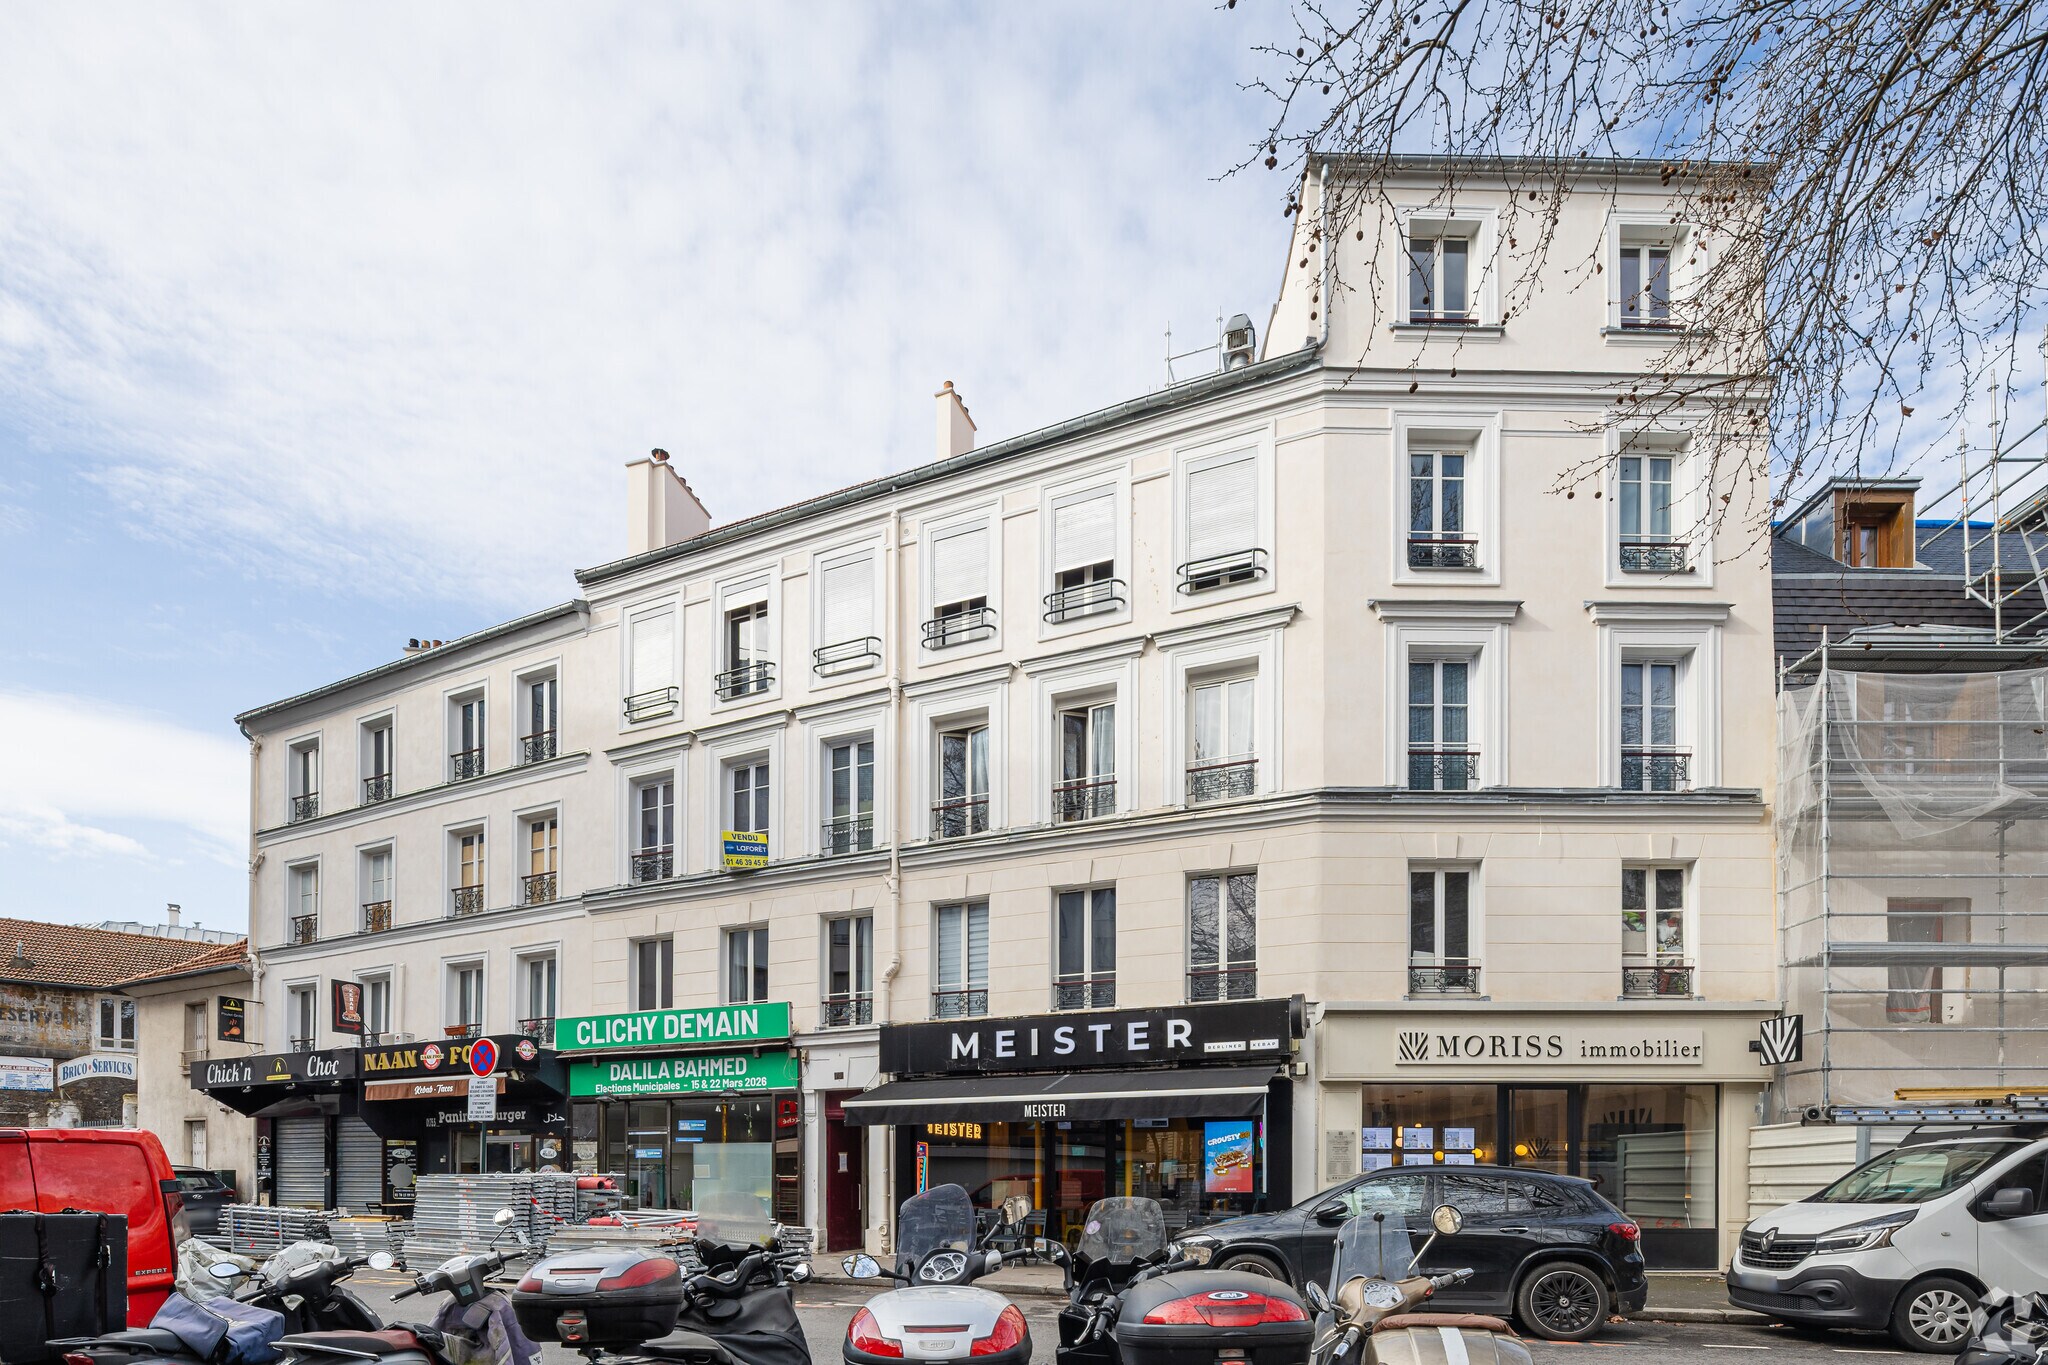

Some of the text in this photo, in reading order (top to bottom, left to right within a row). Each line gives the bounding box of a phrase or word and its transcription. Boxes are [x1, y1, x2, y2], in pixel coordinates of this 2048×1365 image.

[731, 833, 758, 841] VENDU
[576, 1009, 758, 1045] CLICHY DEMAIN
[951, 1019, 1192, 1060] MEISTER
[1436, 1034, 1701, 1058] MORISS immobilier
[62, 1063, 87, 1081] BRICO
[92, 1059, 132, 1075] SERVICES
[207, 1055, 340, 1084] Chick'n Choc
[364, 1050, 417, 1071] NAAN
[609, 1057, 747, 1081] DALILA BAHMED
[414, 1085, 433, 1095] Kebab
[437, 1084, 454, 1093] Tacos
[595, 1083, 632, 1094] Elections
[632, 1081, 680, 1093] Municipales
[691, 1080, 700, 1091] 15
[701, 1080, 709, 1090] &
[710, 1079, 720, 1090] 22
[722, 1078, 743, 1089] Mars
[744, 1077, 767, 1088] 2026
[496, 1110, 526, 1123] urger
[542, 1113, 566, 1124] حلال
[1024, 1103, 1066, 1118] MEISTER
[135, 1268, 167, 1276] EXPERT
